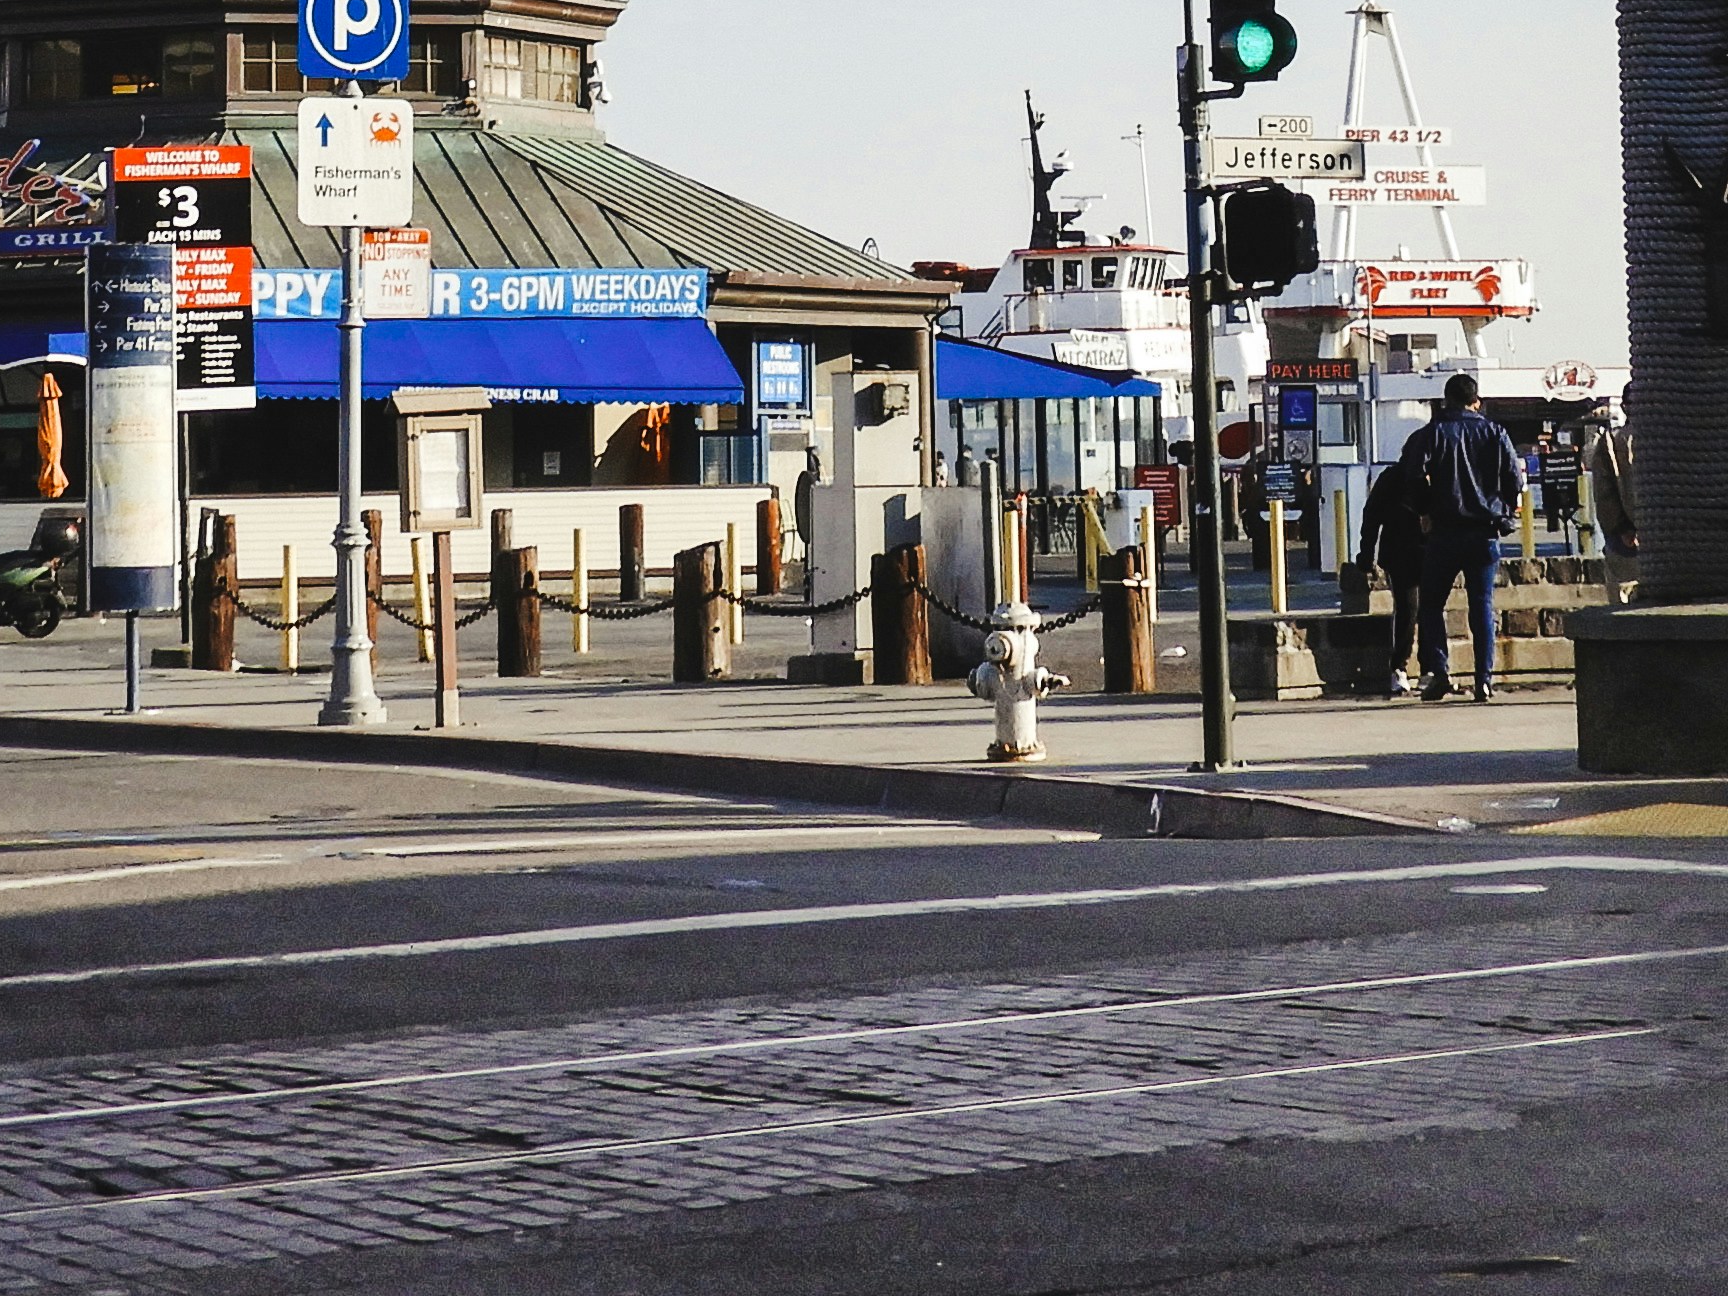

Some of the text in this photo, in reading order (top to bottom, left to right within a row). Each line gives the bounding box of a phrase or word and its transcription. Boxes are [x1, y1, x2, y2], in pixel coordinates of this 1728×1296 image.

[1345, 130, 1442, 143] PIER 43 1/2
[145, 150, 219, 163] WELCOME TO
[1225, 146, 1353, 170] Jefferson
[125, 163, 241, 177] FISHERMAN'S WHARF
[314, 165, 401, 181] Fisherman's
[1375, 170, 1429, 184] CRUISE
[314, 184, 358, 198] Wharf
[1329, 188, 1459, 201] FERRY TERMINAL
[15, 230, 110, 247] GRILL
[148, 231, 176, 243] EACH
[374, 231, 420, 242] TOW-AWAY
[200, 249, 226, 261] MAX
[365, 243, 429, 260] NO STOPPING
[195, 263, 234, 276] FRIDAY
[383, 269, 410, 280] ANY
[1388, 270, 1416, 281] RED
[1431, 270, 1473, 281] WHITE
[200, 279, 227, 290] MAX
[381, 284, 413, 296] TIME
[195, 292, 241, 305] SUNDAY
[252, 272, 332, 317] PPY
[471, 273, 562, 312] 3-6PM
[572, 274, 699, 302] WEEKDAYS
[1411, 288, 1448, 299] FLEET
[573, 302, 698, 314] EXCEPT HOLIDAYS
[1060, 349, 1125, 366] ALCATRAZ
[1272, 363, 1352, 379] PAY HERE
[523, 388, 559, 401] CRAB
